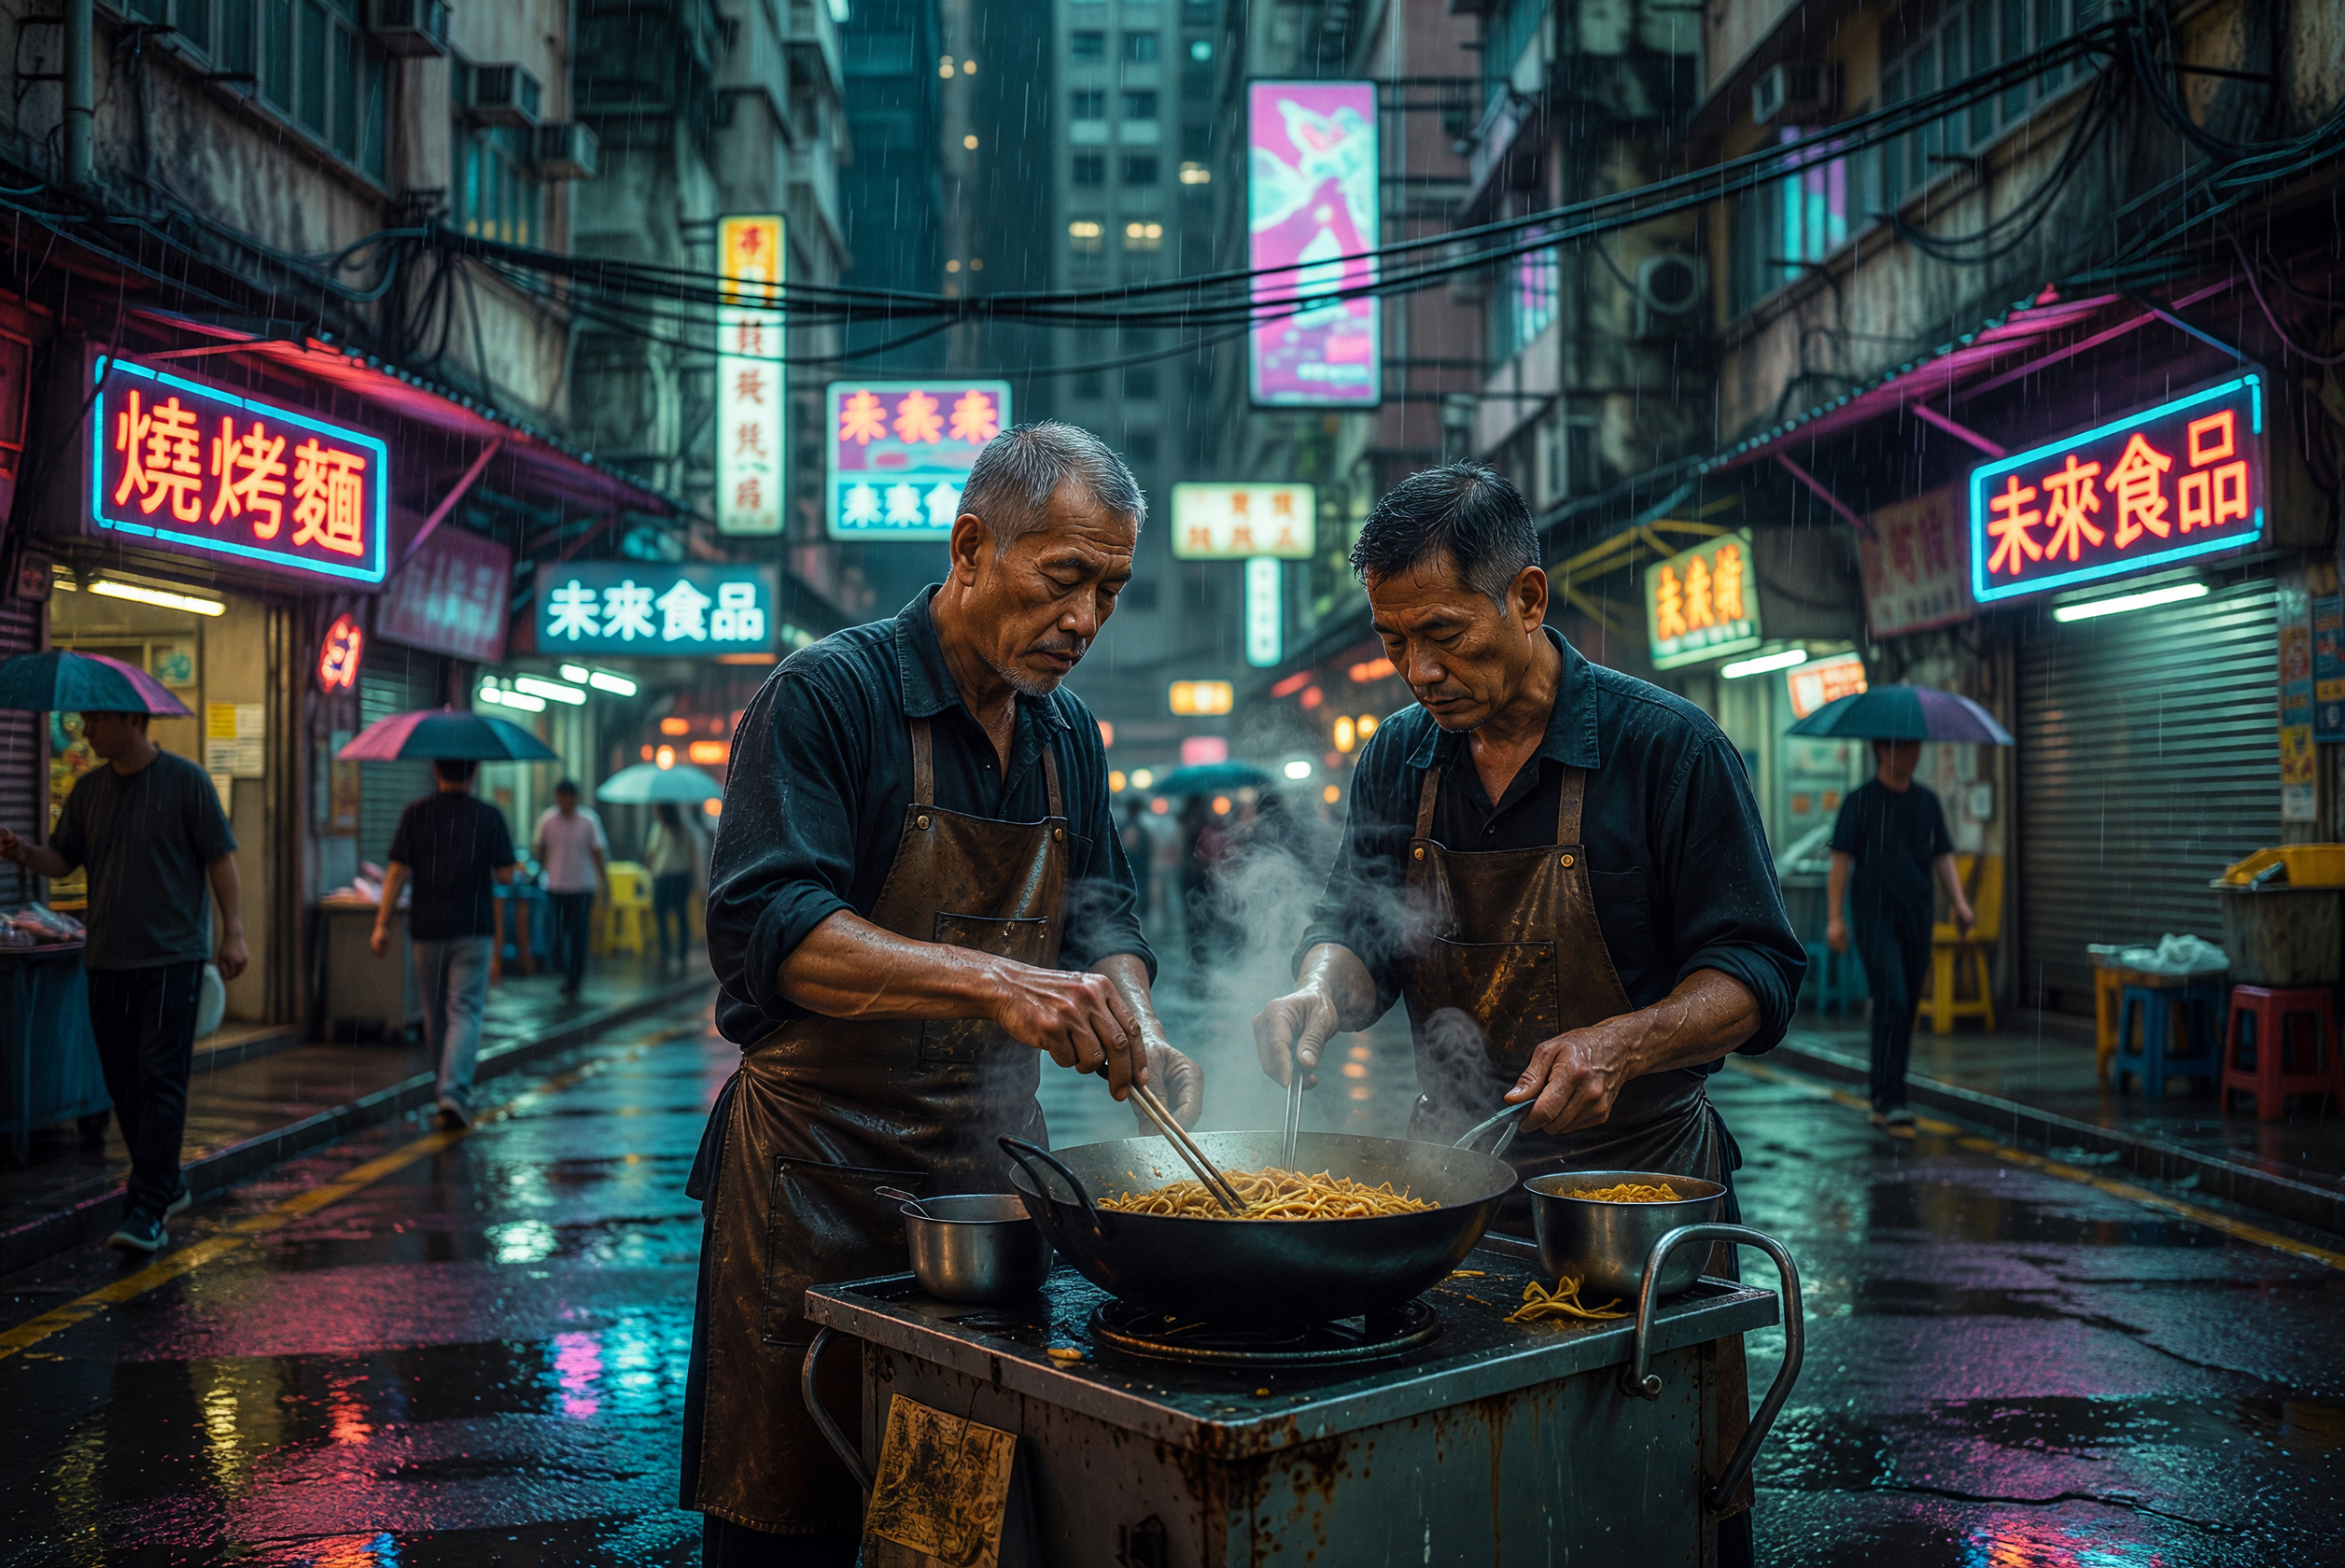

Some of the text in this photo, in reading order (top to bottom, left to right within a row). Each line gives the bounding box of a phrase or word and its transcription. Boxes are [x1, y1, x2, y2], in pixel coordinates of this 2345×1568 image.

[115, 389, 365, 557] 燒烤麵
[1987, 409, 2249, 576] 未來食品
[546, 579, 765, 641] 未來食品
